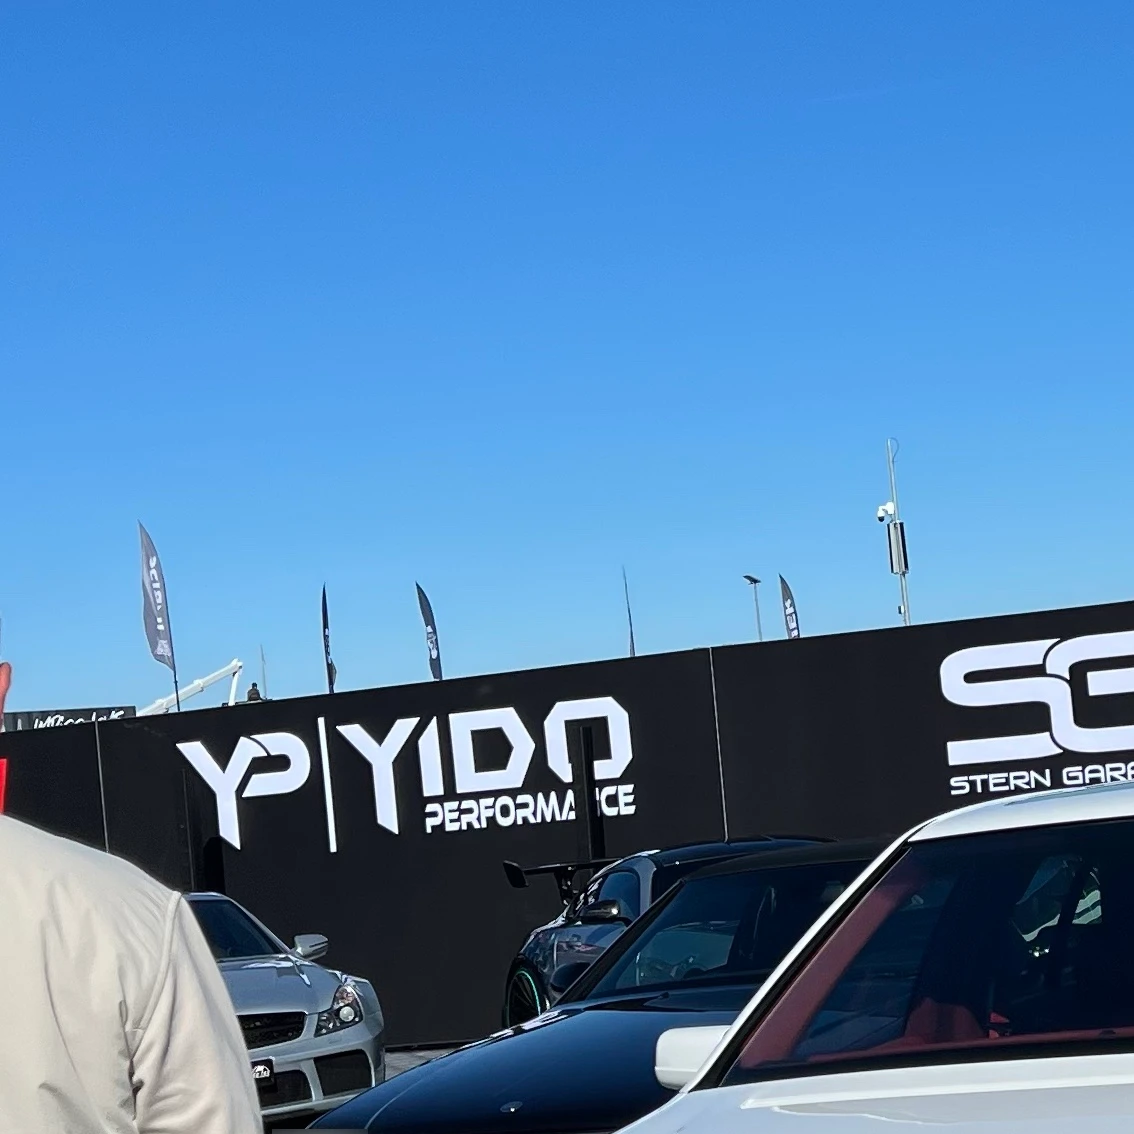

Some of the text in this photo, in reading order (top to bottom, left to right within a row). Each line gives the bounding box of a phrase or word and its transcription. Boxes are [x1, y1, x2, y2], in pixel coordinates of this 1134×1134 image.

[336, 696, 634, 835] YIDO
[949, 768, 1051, 795] STERN
[424, 784, 637, 834] PERFORMACE
